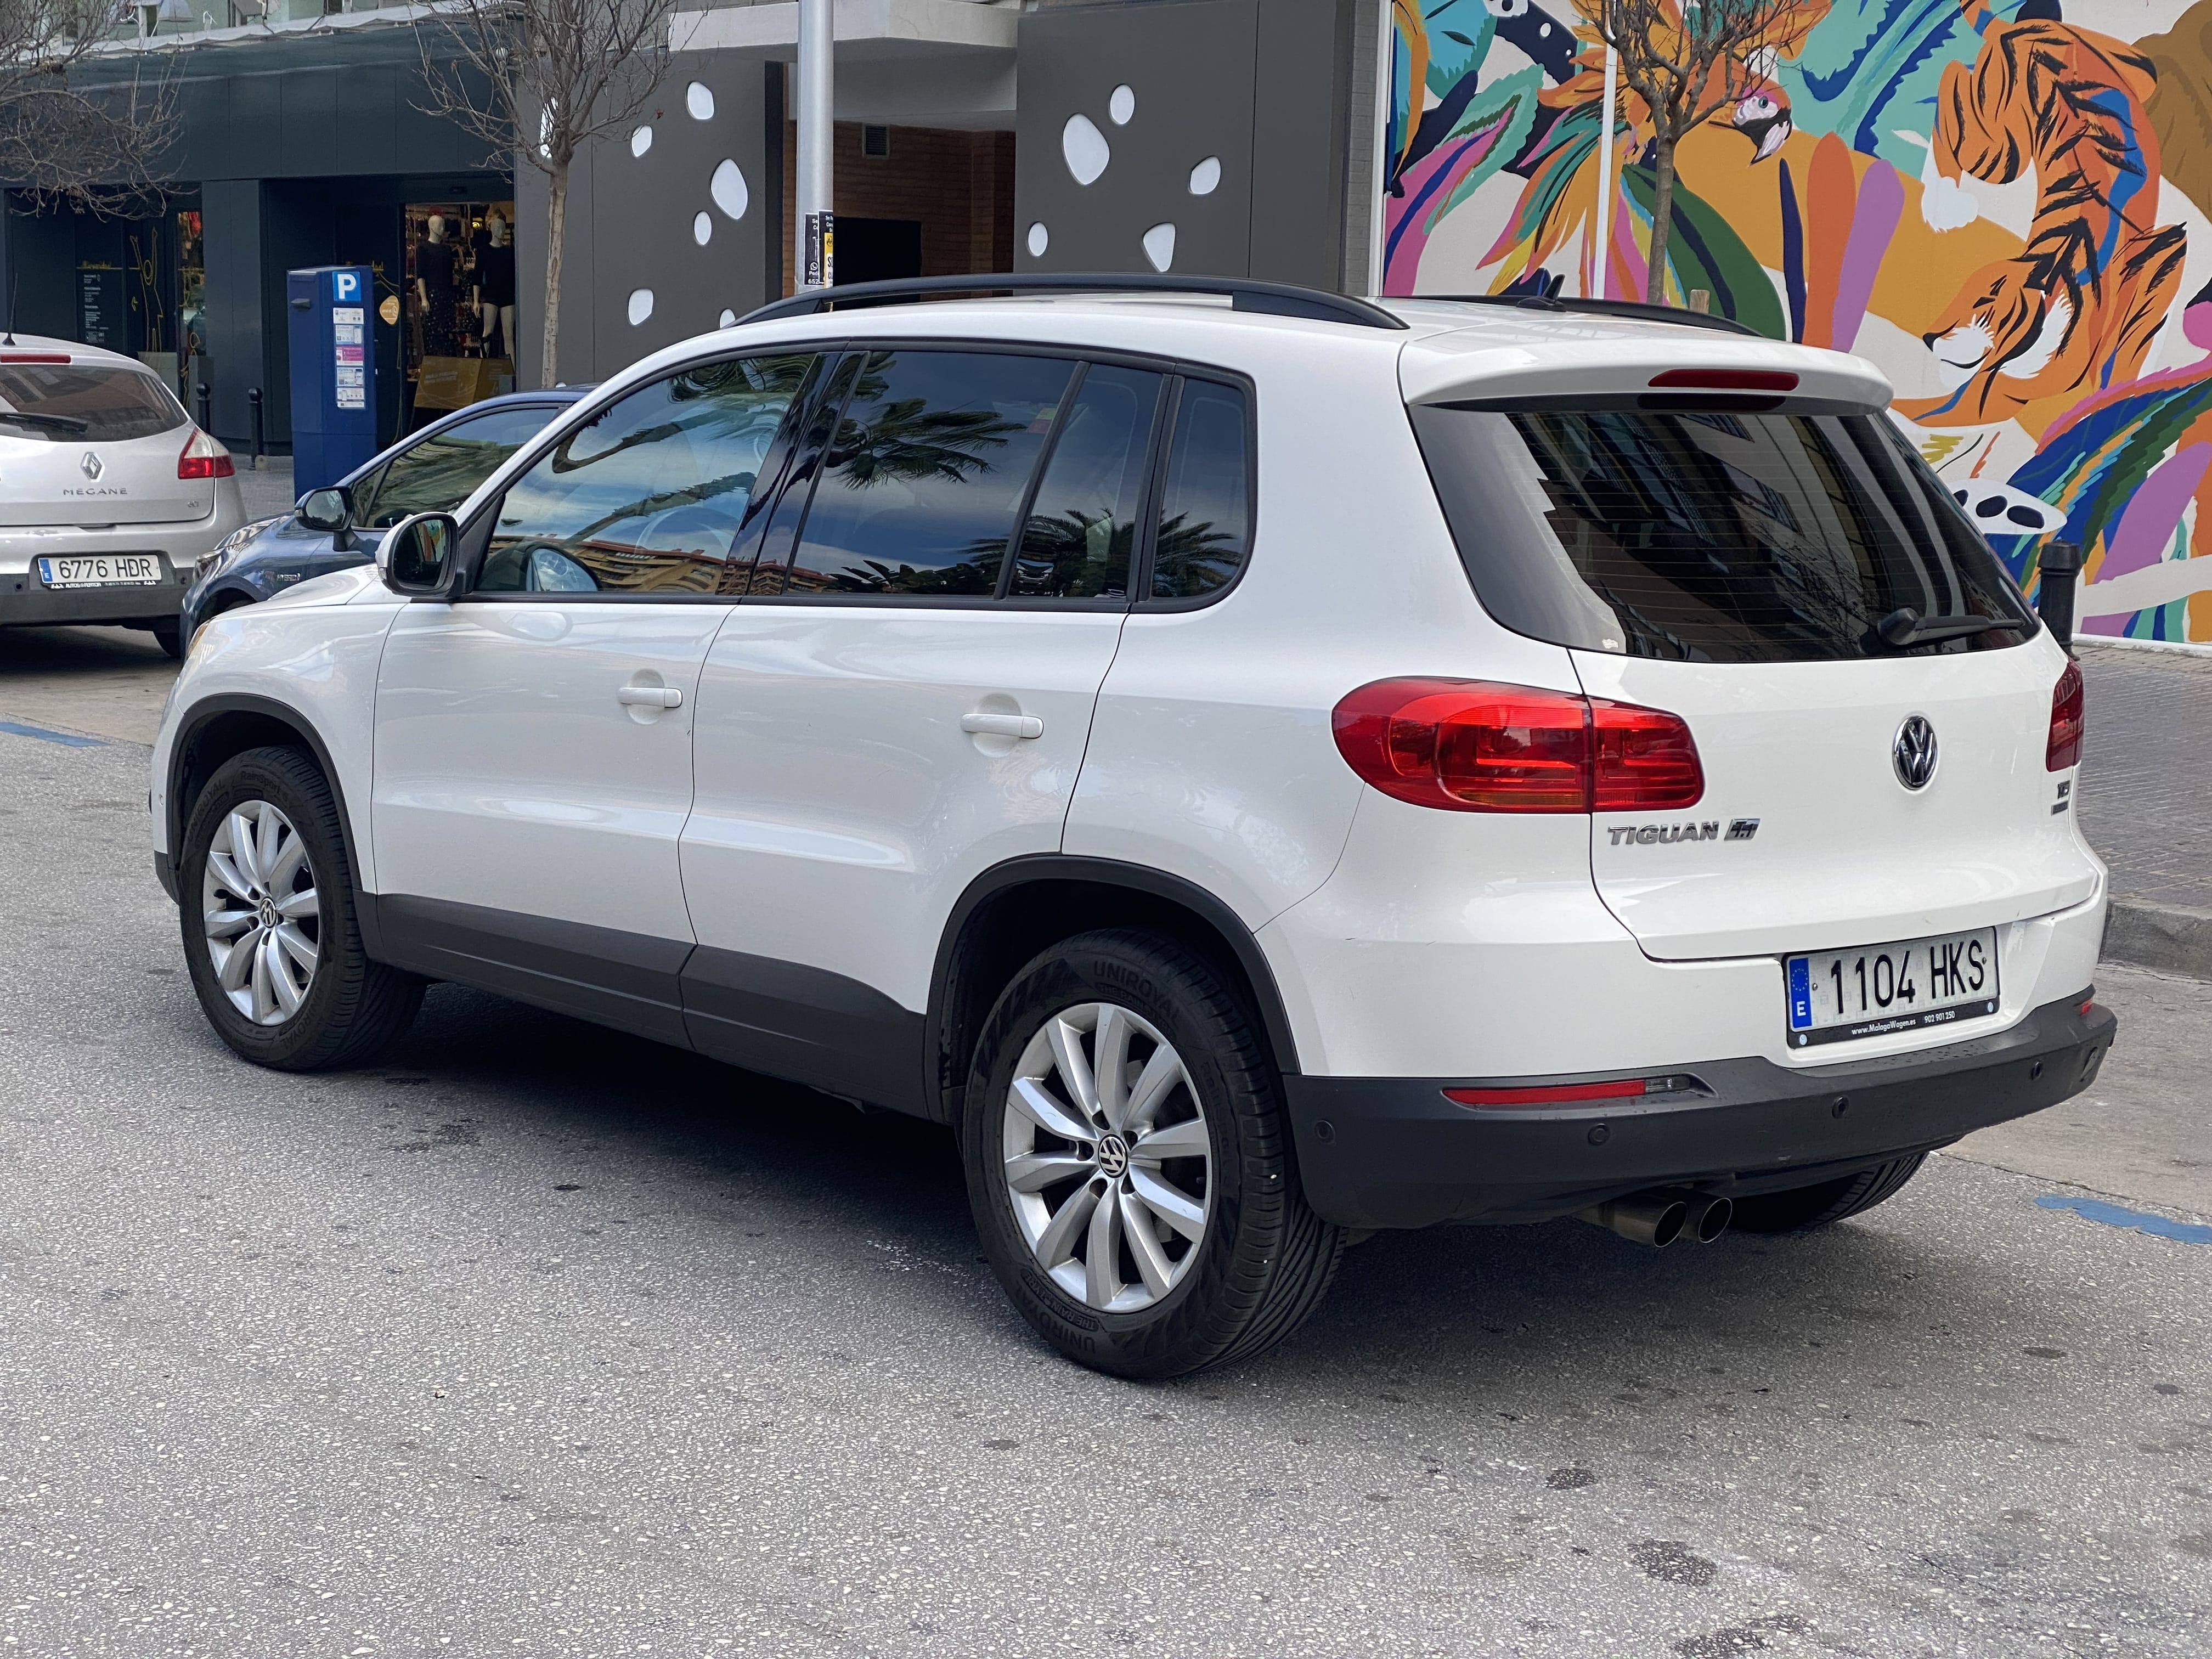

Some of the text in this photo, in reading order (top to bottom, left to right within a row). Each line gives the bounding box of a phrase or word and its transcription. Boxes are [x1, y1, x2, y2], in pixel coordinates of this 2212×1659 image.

[337, 274, 357, 300] P
[59, 558, 153, 579] 6776 HDR
[1607, 820, 1720, 845] TIGUAN
[1831, 939, 1985, 1014] 1104 HKS
[1093, 960, 1181, 1022] UNIROYAL
[1796, 1000, 1807, 1017] E
[1924, 1015, 1935, 1023] 902
[1945, 1011, 1955, 1019] 250
